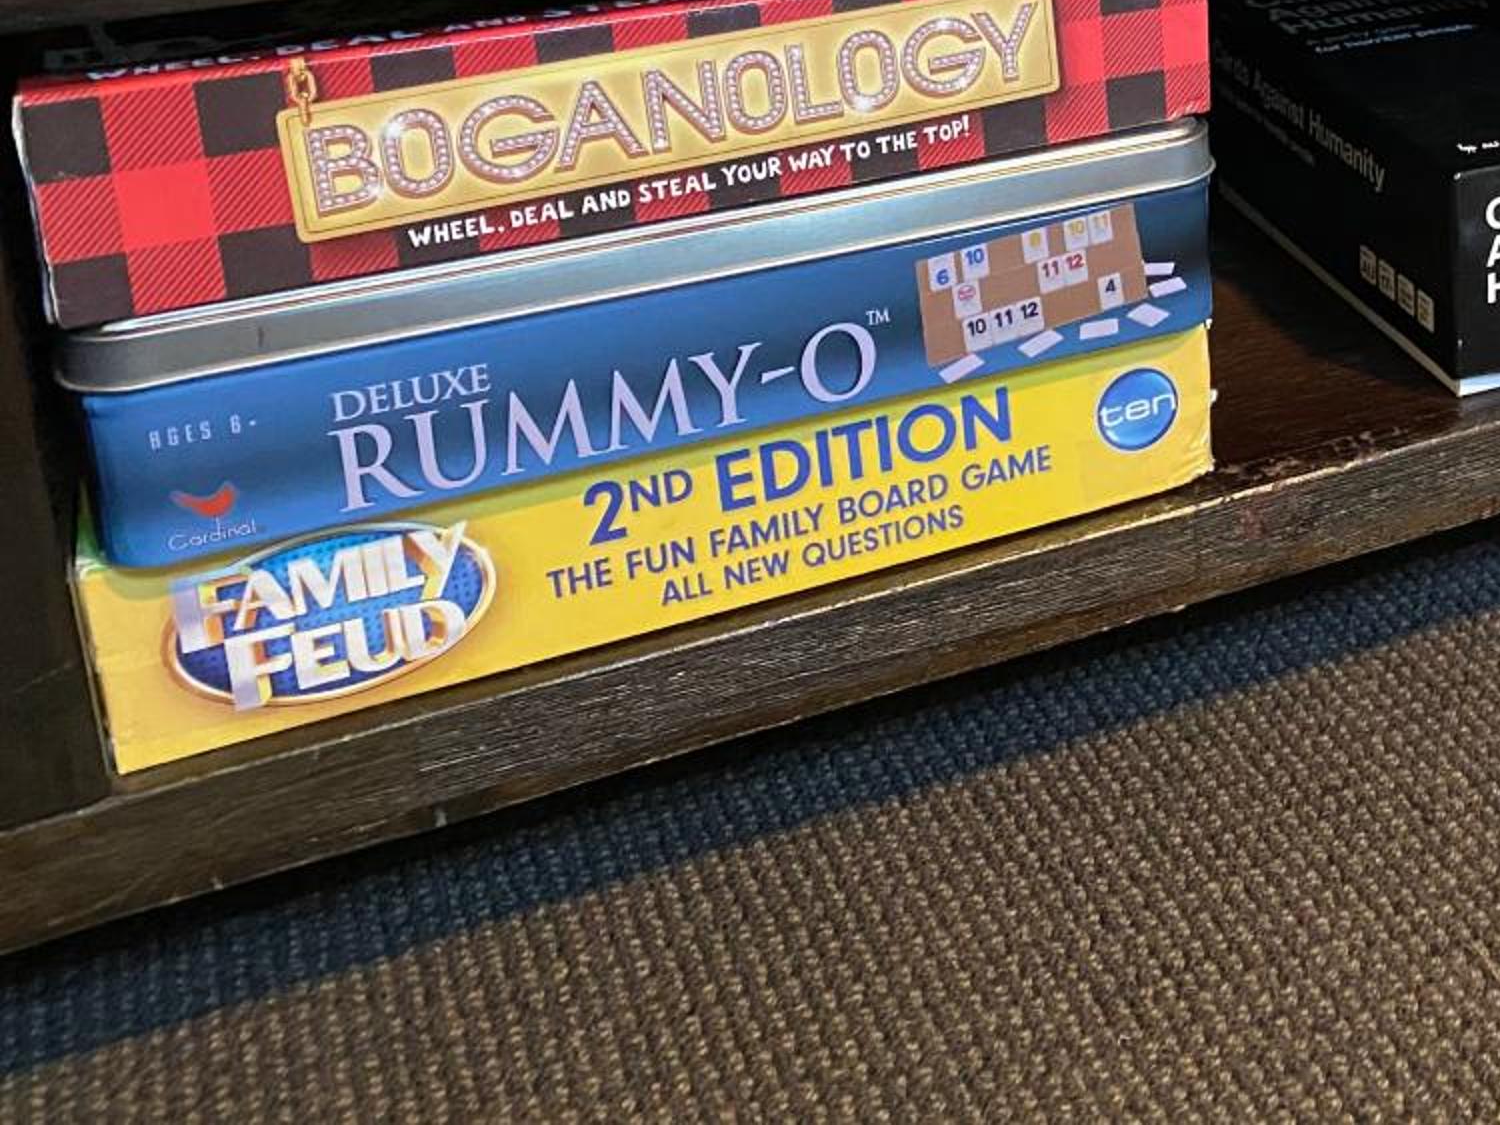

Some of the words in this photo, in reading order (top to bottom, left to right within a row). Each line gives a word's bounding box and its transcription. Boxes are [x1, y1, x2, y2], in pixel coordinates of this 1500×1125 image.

[302, 0, 1039, 216] BOGANOLOGY
[510, 200, 574, 229] DEAL
[581, 189, 632, 215] AND
[637, 172, 717, 204] STEAL
[720, 157, 784, 189] YOUR
[787, 144, 837, 174] WAY
[841, 138, 871, 162] TO
[876, 130, 919, 156] THE
[921, 113, 971, 143] TOP!
[966, 248, 985, 266] 10
[1042, 260, 1060, 278] 11
[1065, 254, 1085, 271] 12
[936, 269, 950, 286] 6
[1105, 278, 1116, 294] 4
[967, 318, 987, 336] 10
[995, 309, 1013, 328] 11
[1020, 302, 1039, 319] 12
[329, 363, 491, 422] DELUXE
[1099, 390, 1176, 428] ten
[326, 322, 878, 512] RUMMY-O
[583, 468, 693, 546] 2ND
[715, 387, 1014, 513] EDITION
[167, 517, 257, 552] Cardinal
[546, 556, 613, 600] THE
[625, 536, 696, 580] FUN
[709, 504, 825, 559] FAMILY
[836, 471, 949, 524] BOARD
[960, 444, 1054, 488] GAME
[660, 571, 714, 607] ALL
[723, 550, 790, 589] NEW
[801, 503, 965, 567] QUESTIONS
[167, 520, 467, 655] FAMILY
[223, 599, 468, 713] FEUD
